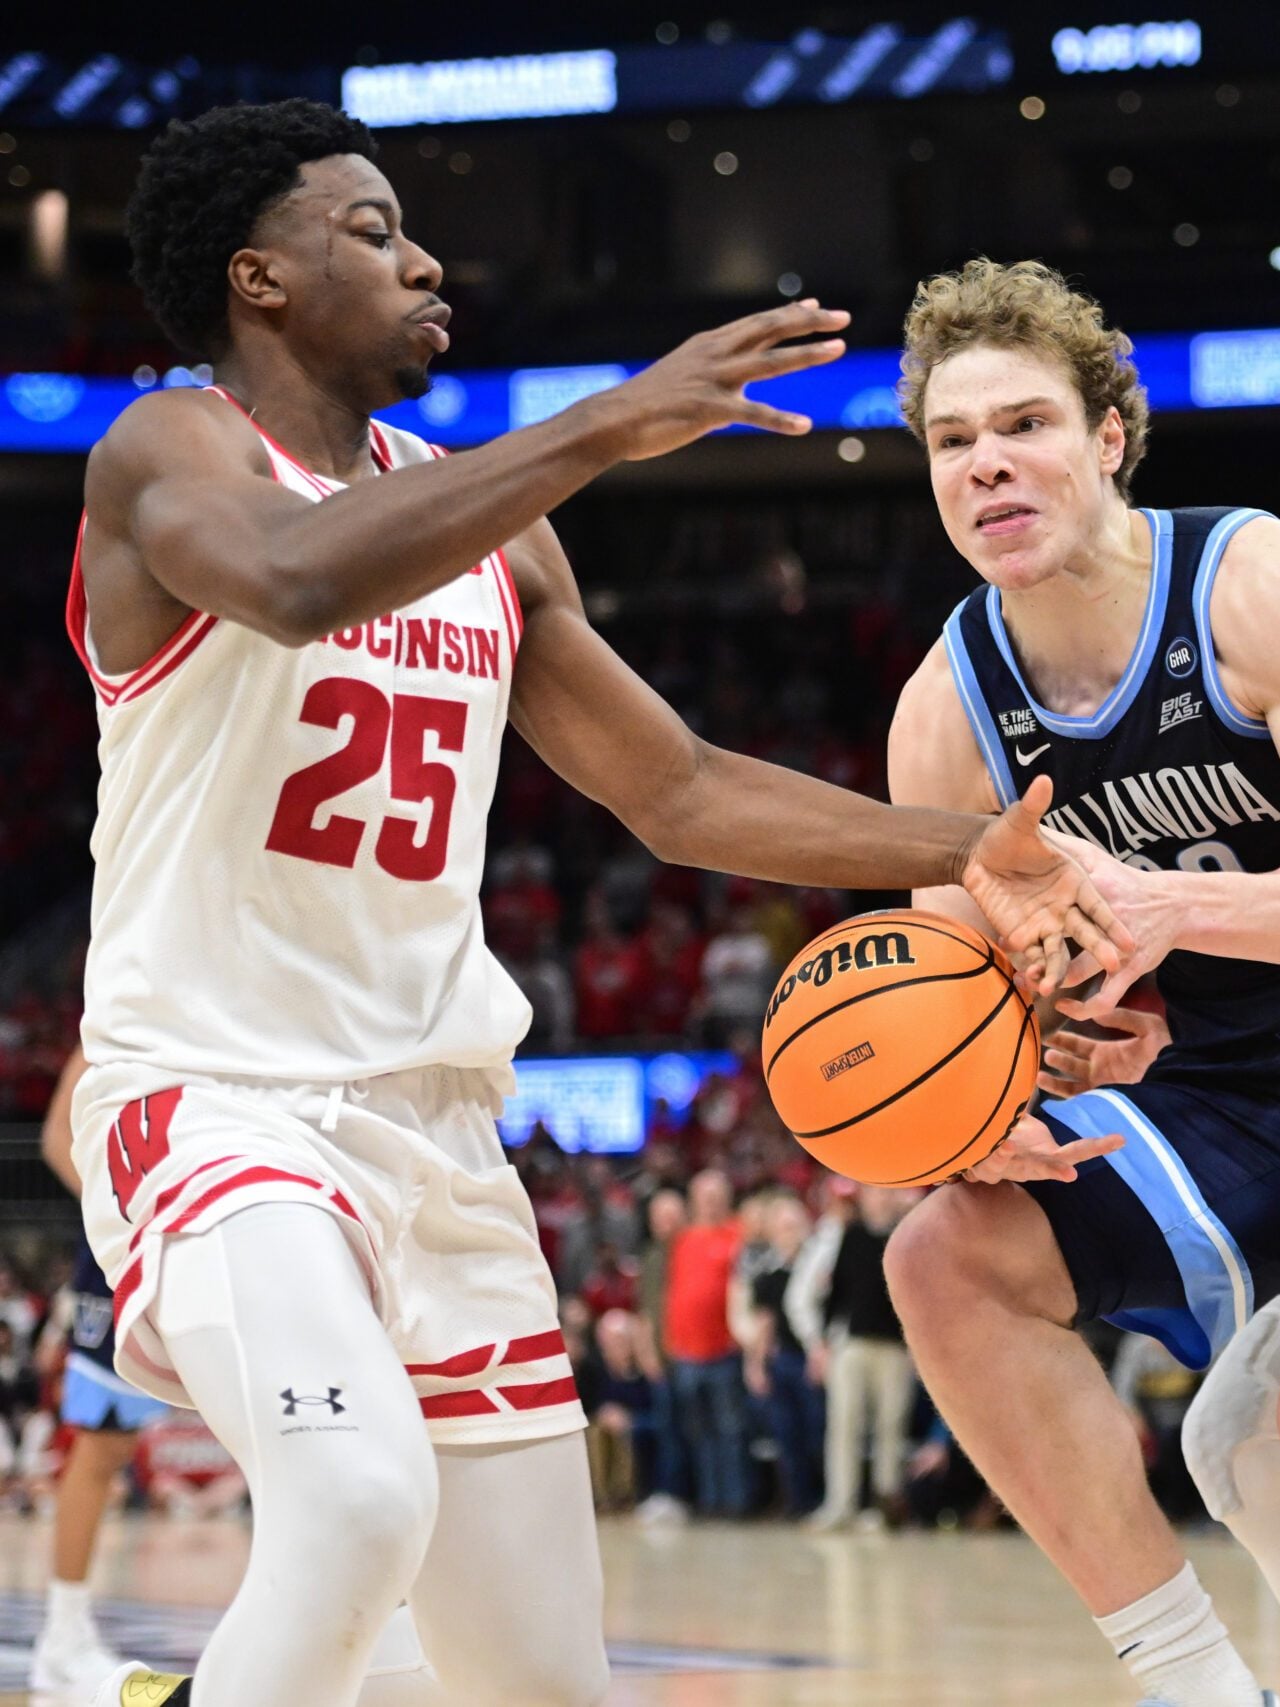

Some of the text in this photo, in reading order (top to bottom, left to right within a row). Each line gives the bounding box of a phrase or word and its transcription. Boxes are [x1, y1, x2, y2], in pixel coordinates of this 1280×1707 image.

[1169, 647, 1191, 669] GHR
[1160, 701, 1203, 726] EAST
[1162, 692, 1192, 714] BIG
[1010, 709, 1033, 723] THE
[1002, 719, 1037, 737] ANGE
[264, 676, 469, 882] 25
[765, 931, 916, 1029] Wilson
